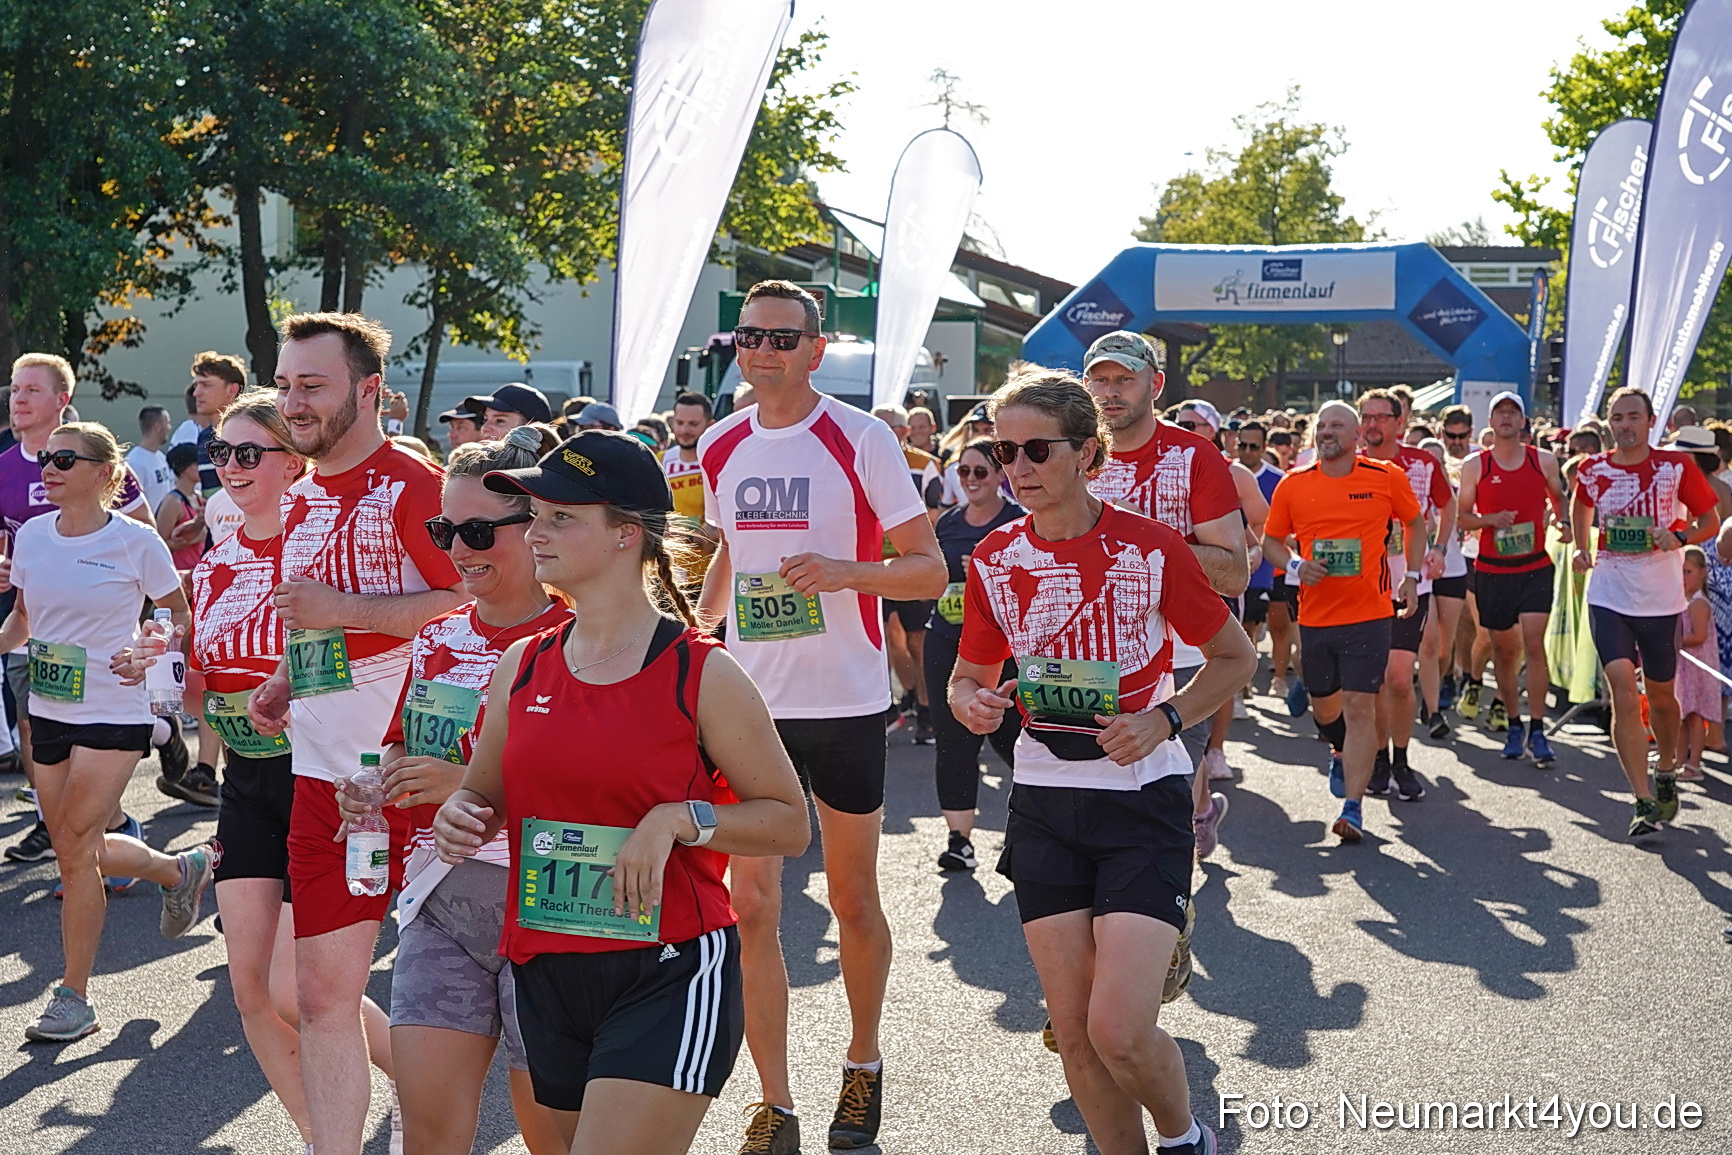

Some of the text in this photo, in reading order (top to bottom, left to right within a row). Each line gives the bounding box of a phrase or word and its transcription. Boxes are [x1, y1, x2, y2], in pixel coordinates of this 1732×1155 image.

[1602, 145, 1648, 248] Fischer
[1247, 281, 1336, 299] firmenlauf
[1076, 309, 1125, 322] Fischer
[736, 510, 808, 520] KLEBE TECHNIK
[1612, 528, 1646, 541] 1099
[737, 604, 748, 628] RUN
[751, 593, 798, 620] 505
[776, 616, 804, 627] Daniel
[34, 659, 74, 684] 1887
[332, 641, 347, 680] 2022
[72, 669, 82, 696] 2022
[1035, 684, 1104, 712] 1102
[216, 716, 263, 738] 113
[249, 738, 262, 746] Lea
[555, 843, 599, 853] Firmenlauf
[525, 869, 538, 907] RUN
[543, 860, 629, 902] 117
[540, 898, 574, 914] Rackl
